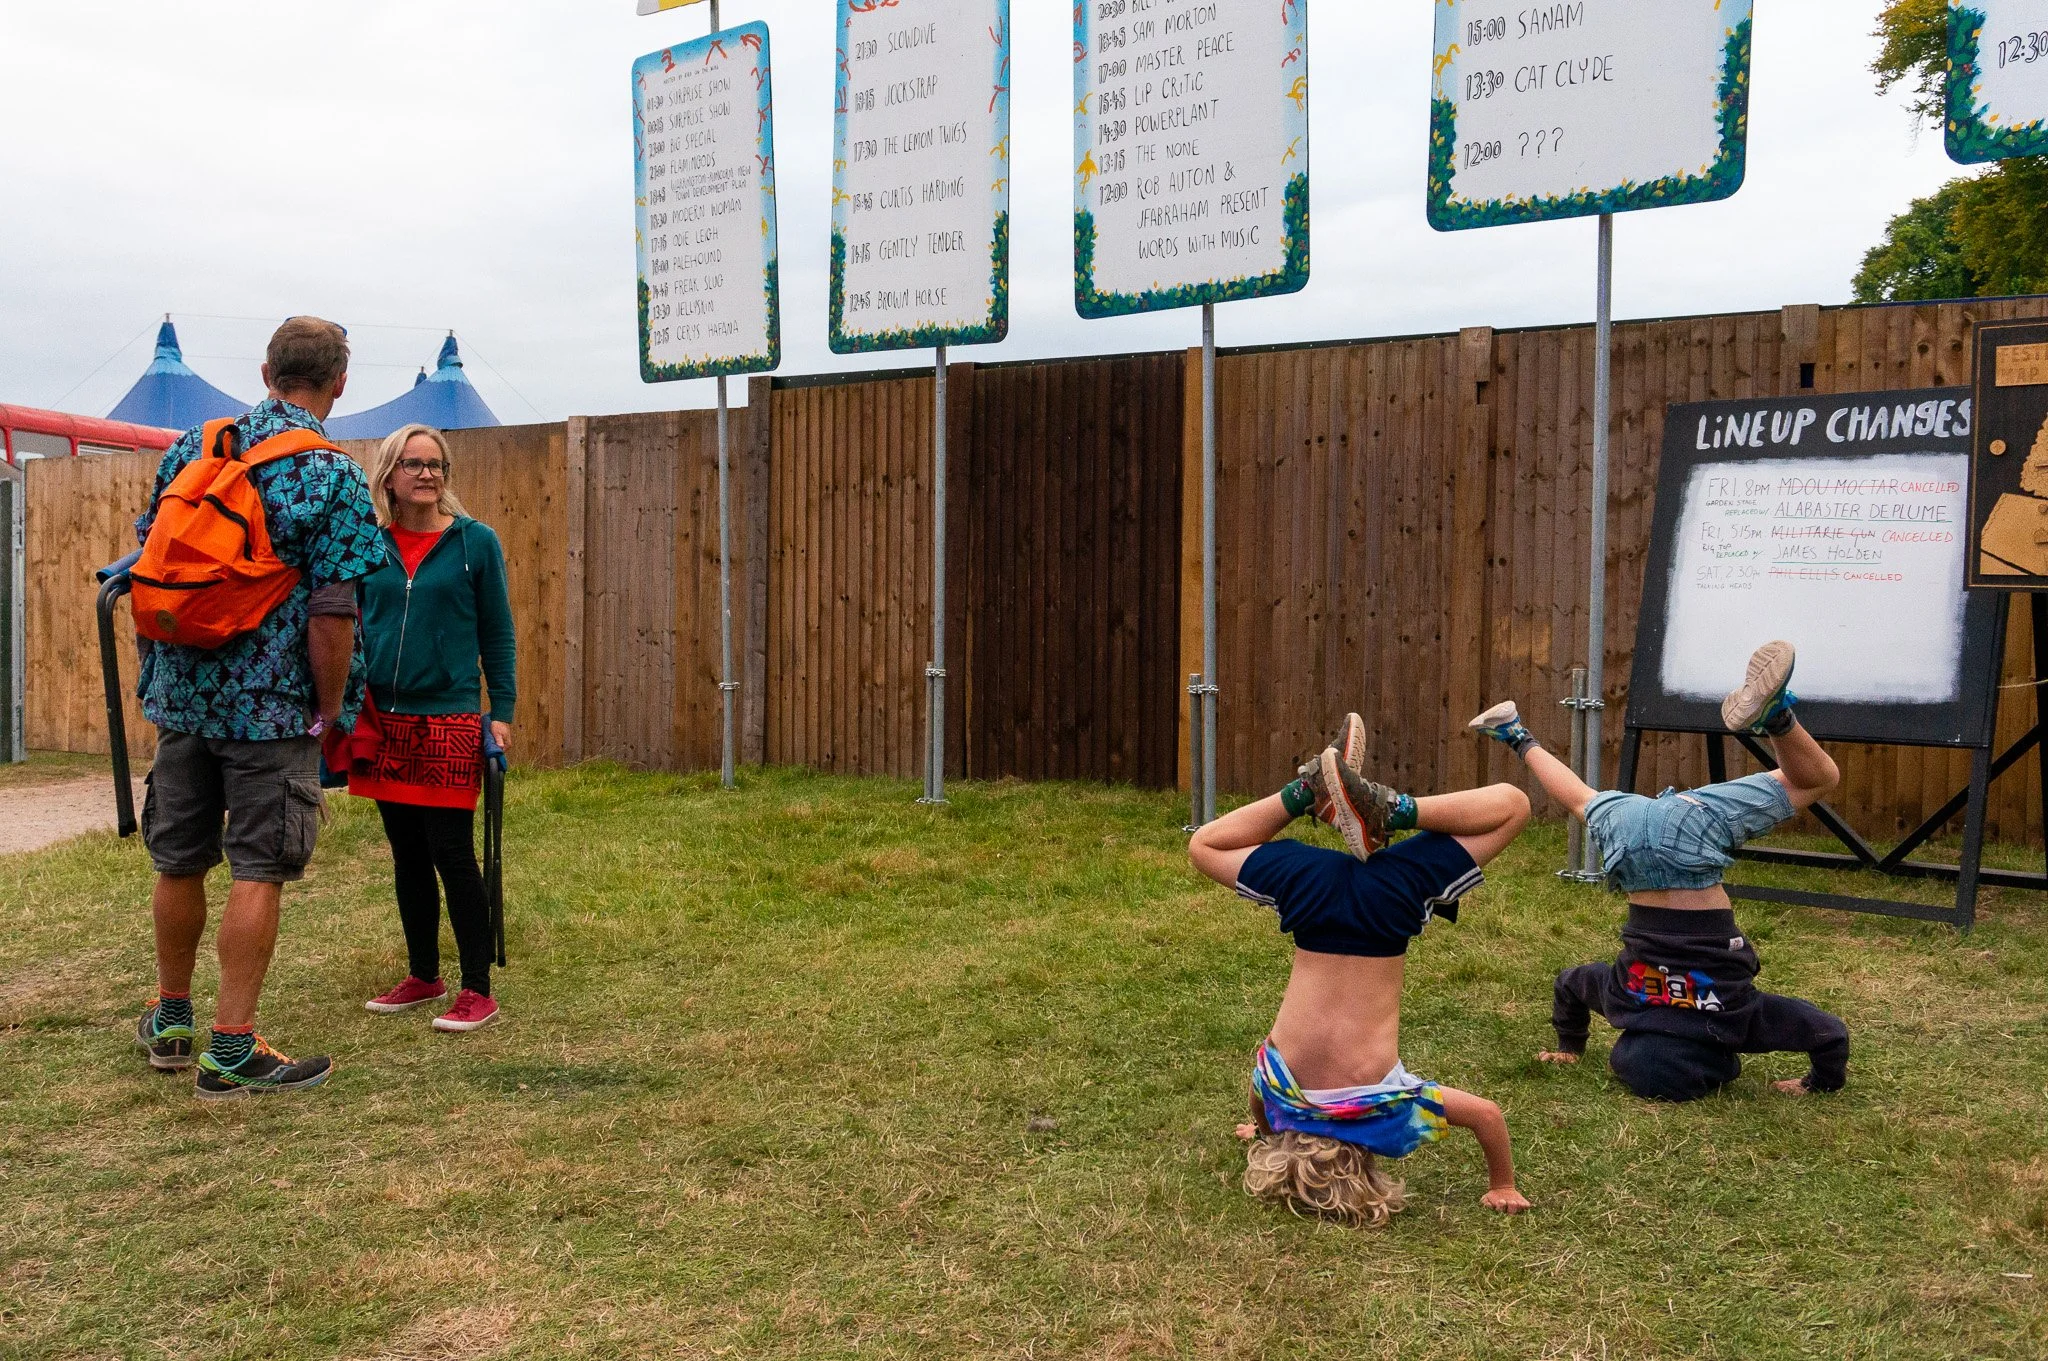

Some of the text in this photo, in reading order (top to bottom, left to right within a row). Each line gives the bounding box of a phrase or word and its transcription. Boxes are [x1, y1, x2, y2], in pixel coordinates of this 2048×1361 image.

[1098, 0, 1126, 21] 20:30
[1467, 1, 1583, 46] 15:00 SANAM
[1098, 4, 1217, 53] 18:45 SAM MORTON
[1098, 31, 1235, 84] 17:00 MASTER PEACE
[1998, 31, 2048, 69] 12:30
[885, 75, 937, 106] JOCKSTRAP
[1466, 54, 1614, 101] 13:30 CAT CLYDE
[669, 84, 702, 106] SURPRISE
[709, 78, 730, 96] SHOW
[1098, 87, 1126, 115] 15:45
[669, 107, 703, 130] SURPRISE
[710, 101, 730, 119] SHOW
[1099, 98, 1220, 145] 14:30 POWERPLANT
[685, 129, 716, 149] SPECIAL
[853, 139, 878, 162] 17:30
[883, 135, 898, 155] THE
[903, 128, 933, 153] LEMON
[1099, 139, 1200, 176] 13:15 THE NONE
[1464, 140, 1502, 170] 12:00
[1099, 161, 1237, 206] 12:00 ROB AUTON &
[672, 204, 705, 223] MODERN
[711, 199, 742, 216] WOMAN
[1137, 186, 1269, 230] JFABRAHAM PRESENT
[879, 234, 918, 260] GENTLY
[928, 230, 965, 254] TENDER
[1139, 237, 1179, 260] WORDS
[673, 249, 722, 271] PALEHOUND
[674, 278, 699, 296] FREAK
[704, 274, 723, 291] SLUG
[878, 288, 909, 310] BROWN
[915, 287, 948, 307] HORSE
[676, 323, 700, 342] CERYS
[1825, 399, 1971, 443] CHANGES
[1745, 478, 1770, 497] 8PM
[1778, 477, 1830, 497] MDOU
[1836, 478, 1899, 497] MOCTAR
[1900, 481, 1960, 493] CANCELLED
[1706, 499, 1733, 507] GARDEN
[1774, 501, 1861, 518] ALABASTER
[1882, 530, 1953, 543] CANCELLED
[1772, 544, 1817, 560] JAMES
[1828, 545, 1882, 560] HOLDEN
[1729, 582, 1752, 590] HEADS
[1843, 571, 1902, 582] CANCELLED
